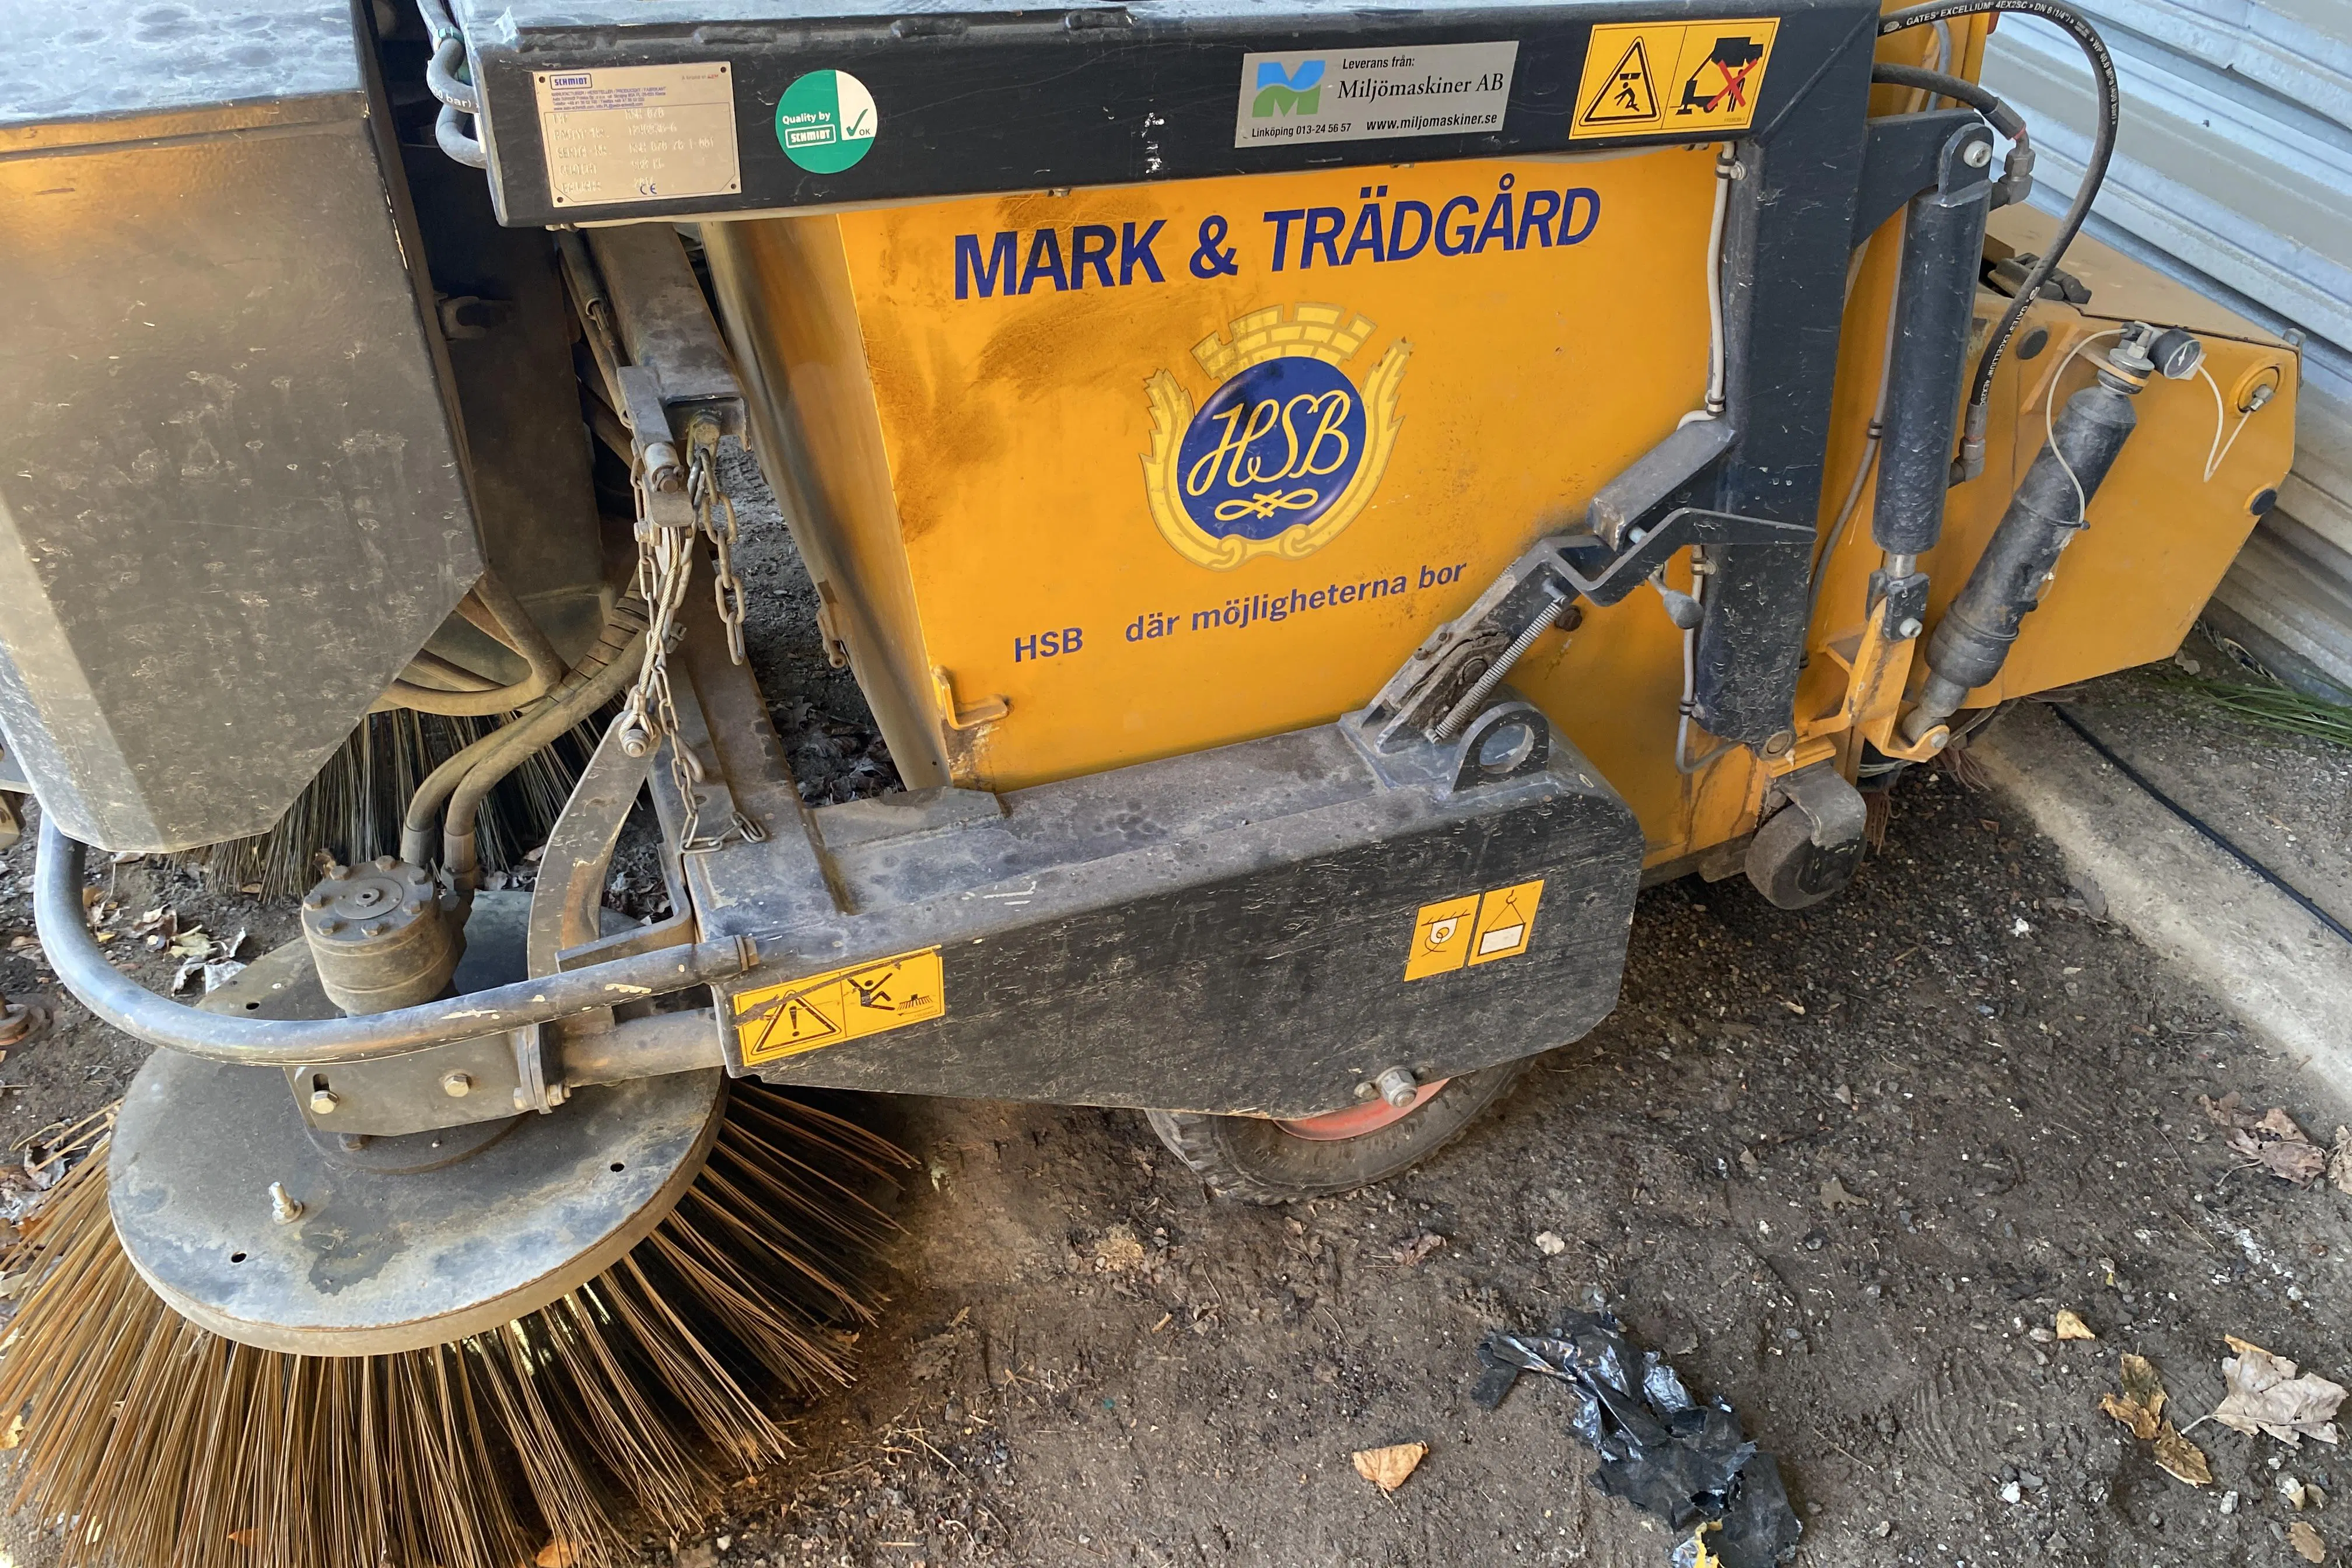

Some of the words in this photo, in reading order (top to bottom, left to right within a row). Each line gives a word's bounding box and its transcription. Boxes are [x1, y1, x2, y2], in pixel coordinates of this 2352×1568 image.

[2034, 3, 2047, 12] DN
[2092, 39, 2104, 52] WP
[1343, 58, 1389, 70] Leverans
[1391, 55, 1416, 68] från:
[554, 77, 587, 86] SCHMIDT
[1337, 75, 1472, 104] Miljömaskiner
[1475, 72, 1504, 92] AB
[446, 93, 471, 108] bar)
[782, 113, 816, 125] Quality
[818, 111, 831, 122] by
[1366, 113, 1497, 131] www.miljomaskiner.se
[791, 129, 831, 143] SCHMIDT
[859, 128, 870, 136] OK
[1251, 124, 1294, 140] Linköping
[1296, 123, 1326, 135] 013-24
[1328, 123, 1339, 133] 56
[1340, 122, 1352, 132] 57
[954, 218, 1168, 300] MARK
[1189, 214, 1238, 279] &
[1262, 173, 1602, 273] TRÄDGÅRD
[1186, 390, 1352, 497] HSB
[1014, 626, 1083, 663] HSB
[1126, 611, 1181, 642] där
[1192, 574, 1407, 631] möjligheterna
[1418, 562, 1468, 590] bor
